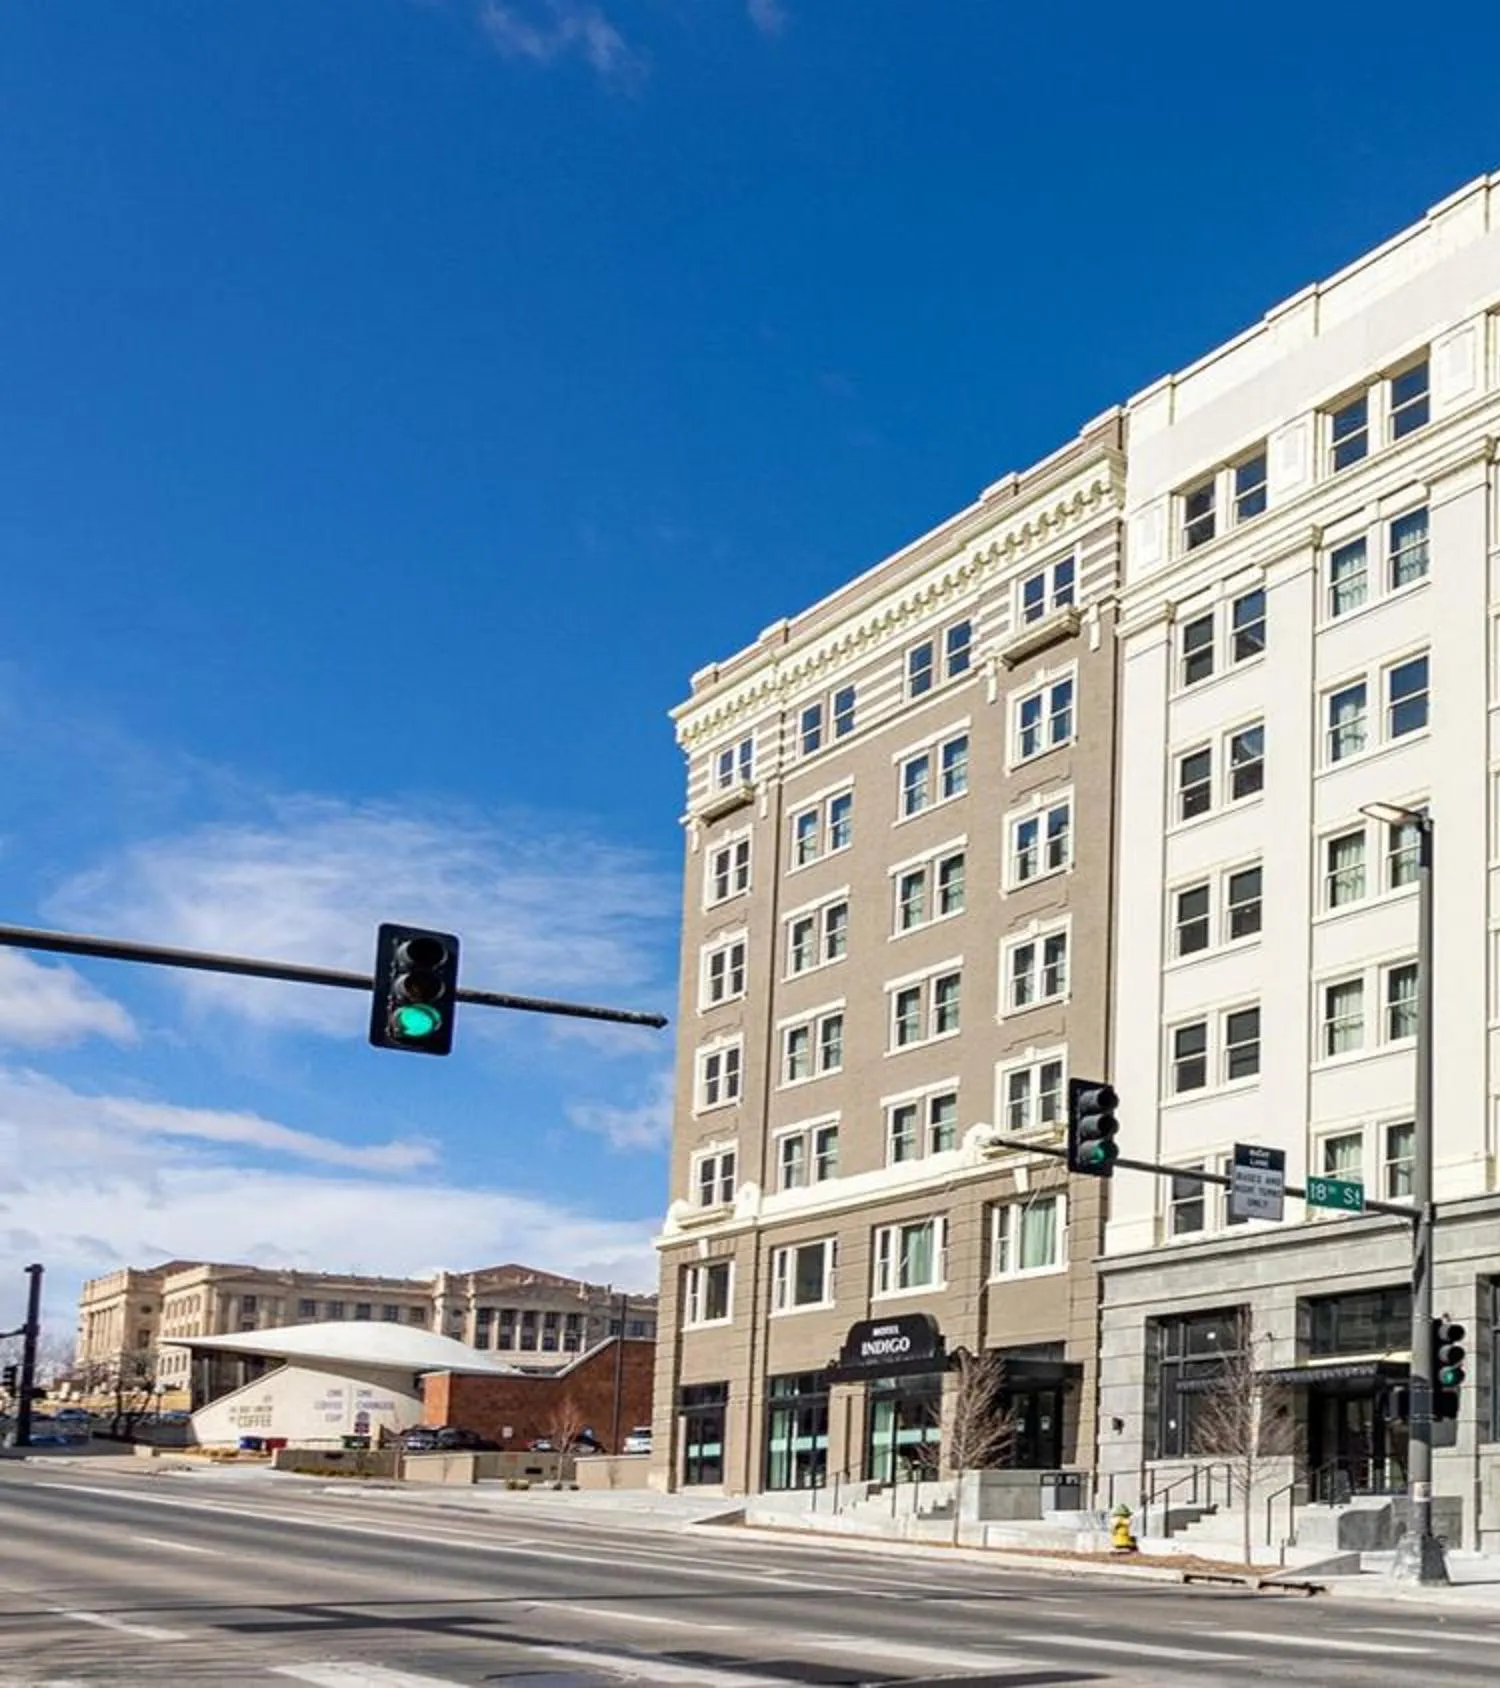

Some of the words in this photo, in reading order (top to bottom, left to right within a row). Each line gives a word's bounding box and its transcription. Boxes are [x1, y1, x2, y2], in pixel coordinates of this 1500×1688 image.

[1343, 1187, 1361, 1205] St
[872, 1325, 899, 1337] HOTEL
[861, 1336, 911, 1356] INDIGO
